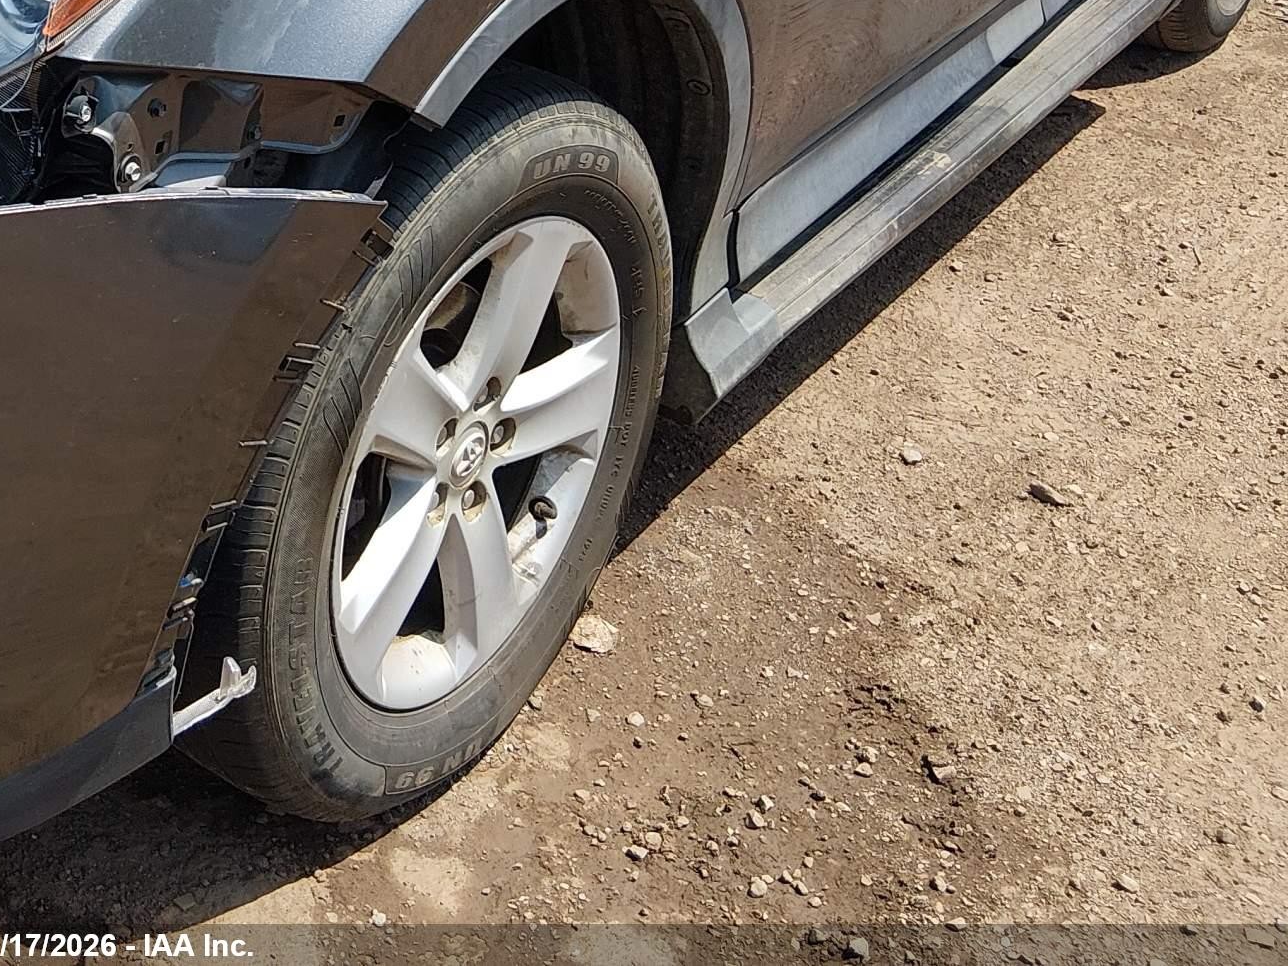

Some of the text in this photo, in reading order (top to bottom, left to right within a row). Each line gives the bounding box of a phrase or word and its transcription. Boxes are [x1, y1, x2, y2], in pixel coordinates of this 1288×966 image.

[533, 151, 611, 180] UN 99
[394, 766, 435, 789] 99
